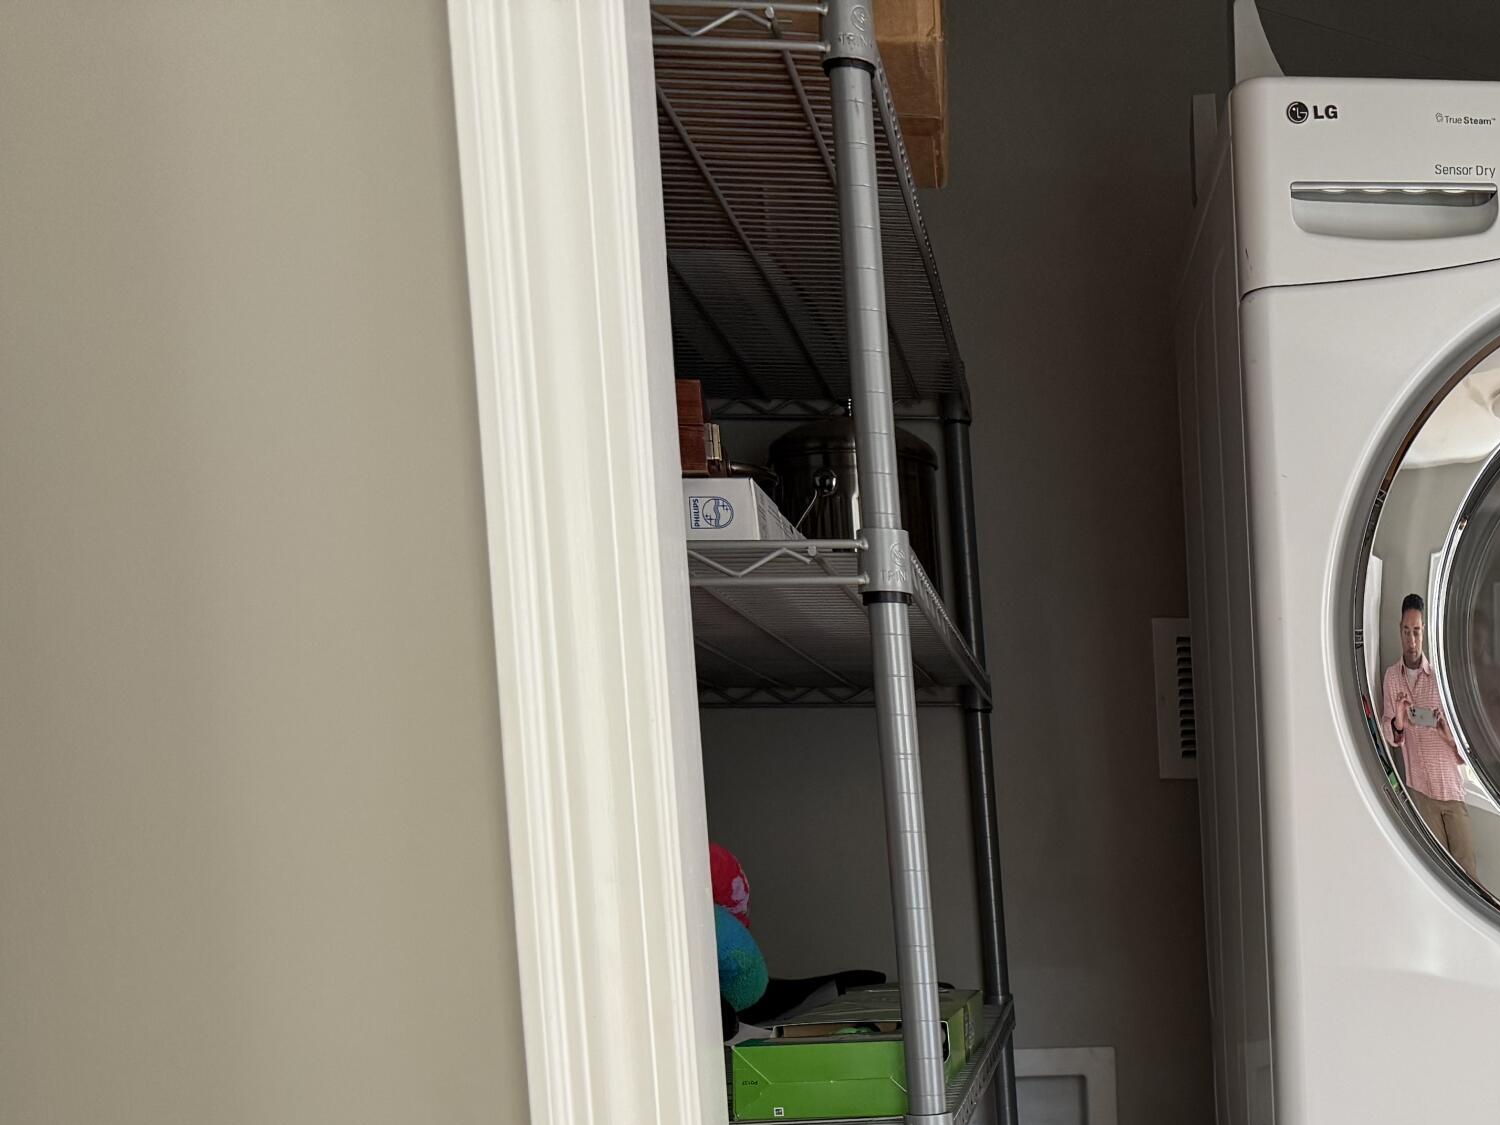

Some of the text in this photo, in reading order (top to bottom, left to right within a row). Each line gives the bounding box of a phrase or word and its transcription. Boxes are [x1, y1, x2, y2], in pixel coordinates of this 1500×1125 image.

[1313, 105, 1338, 119] LG
[1435, 164, 1496, 178] Sensor Dry
